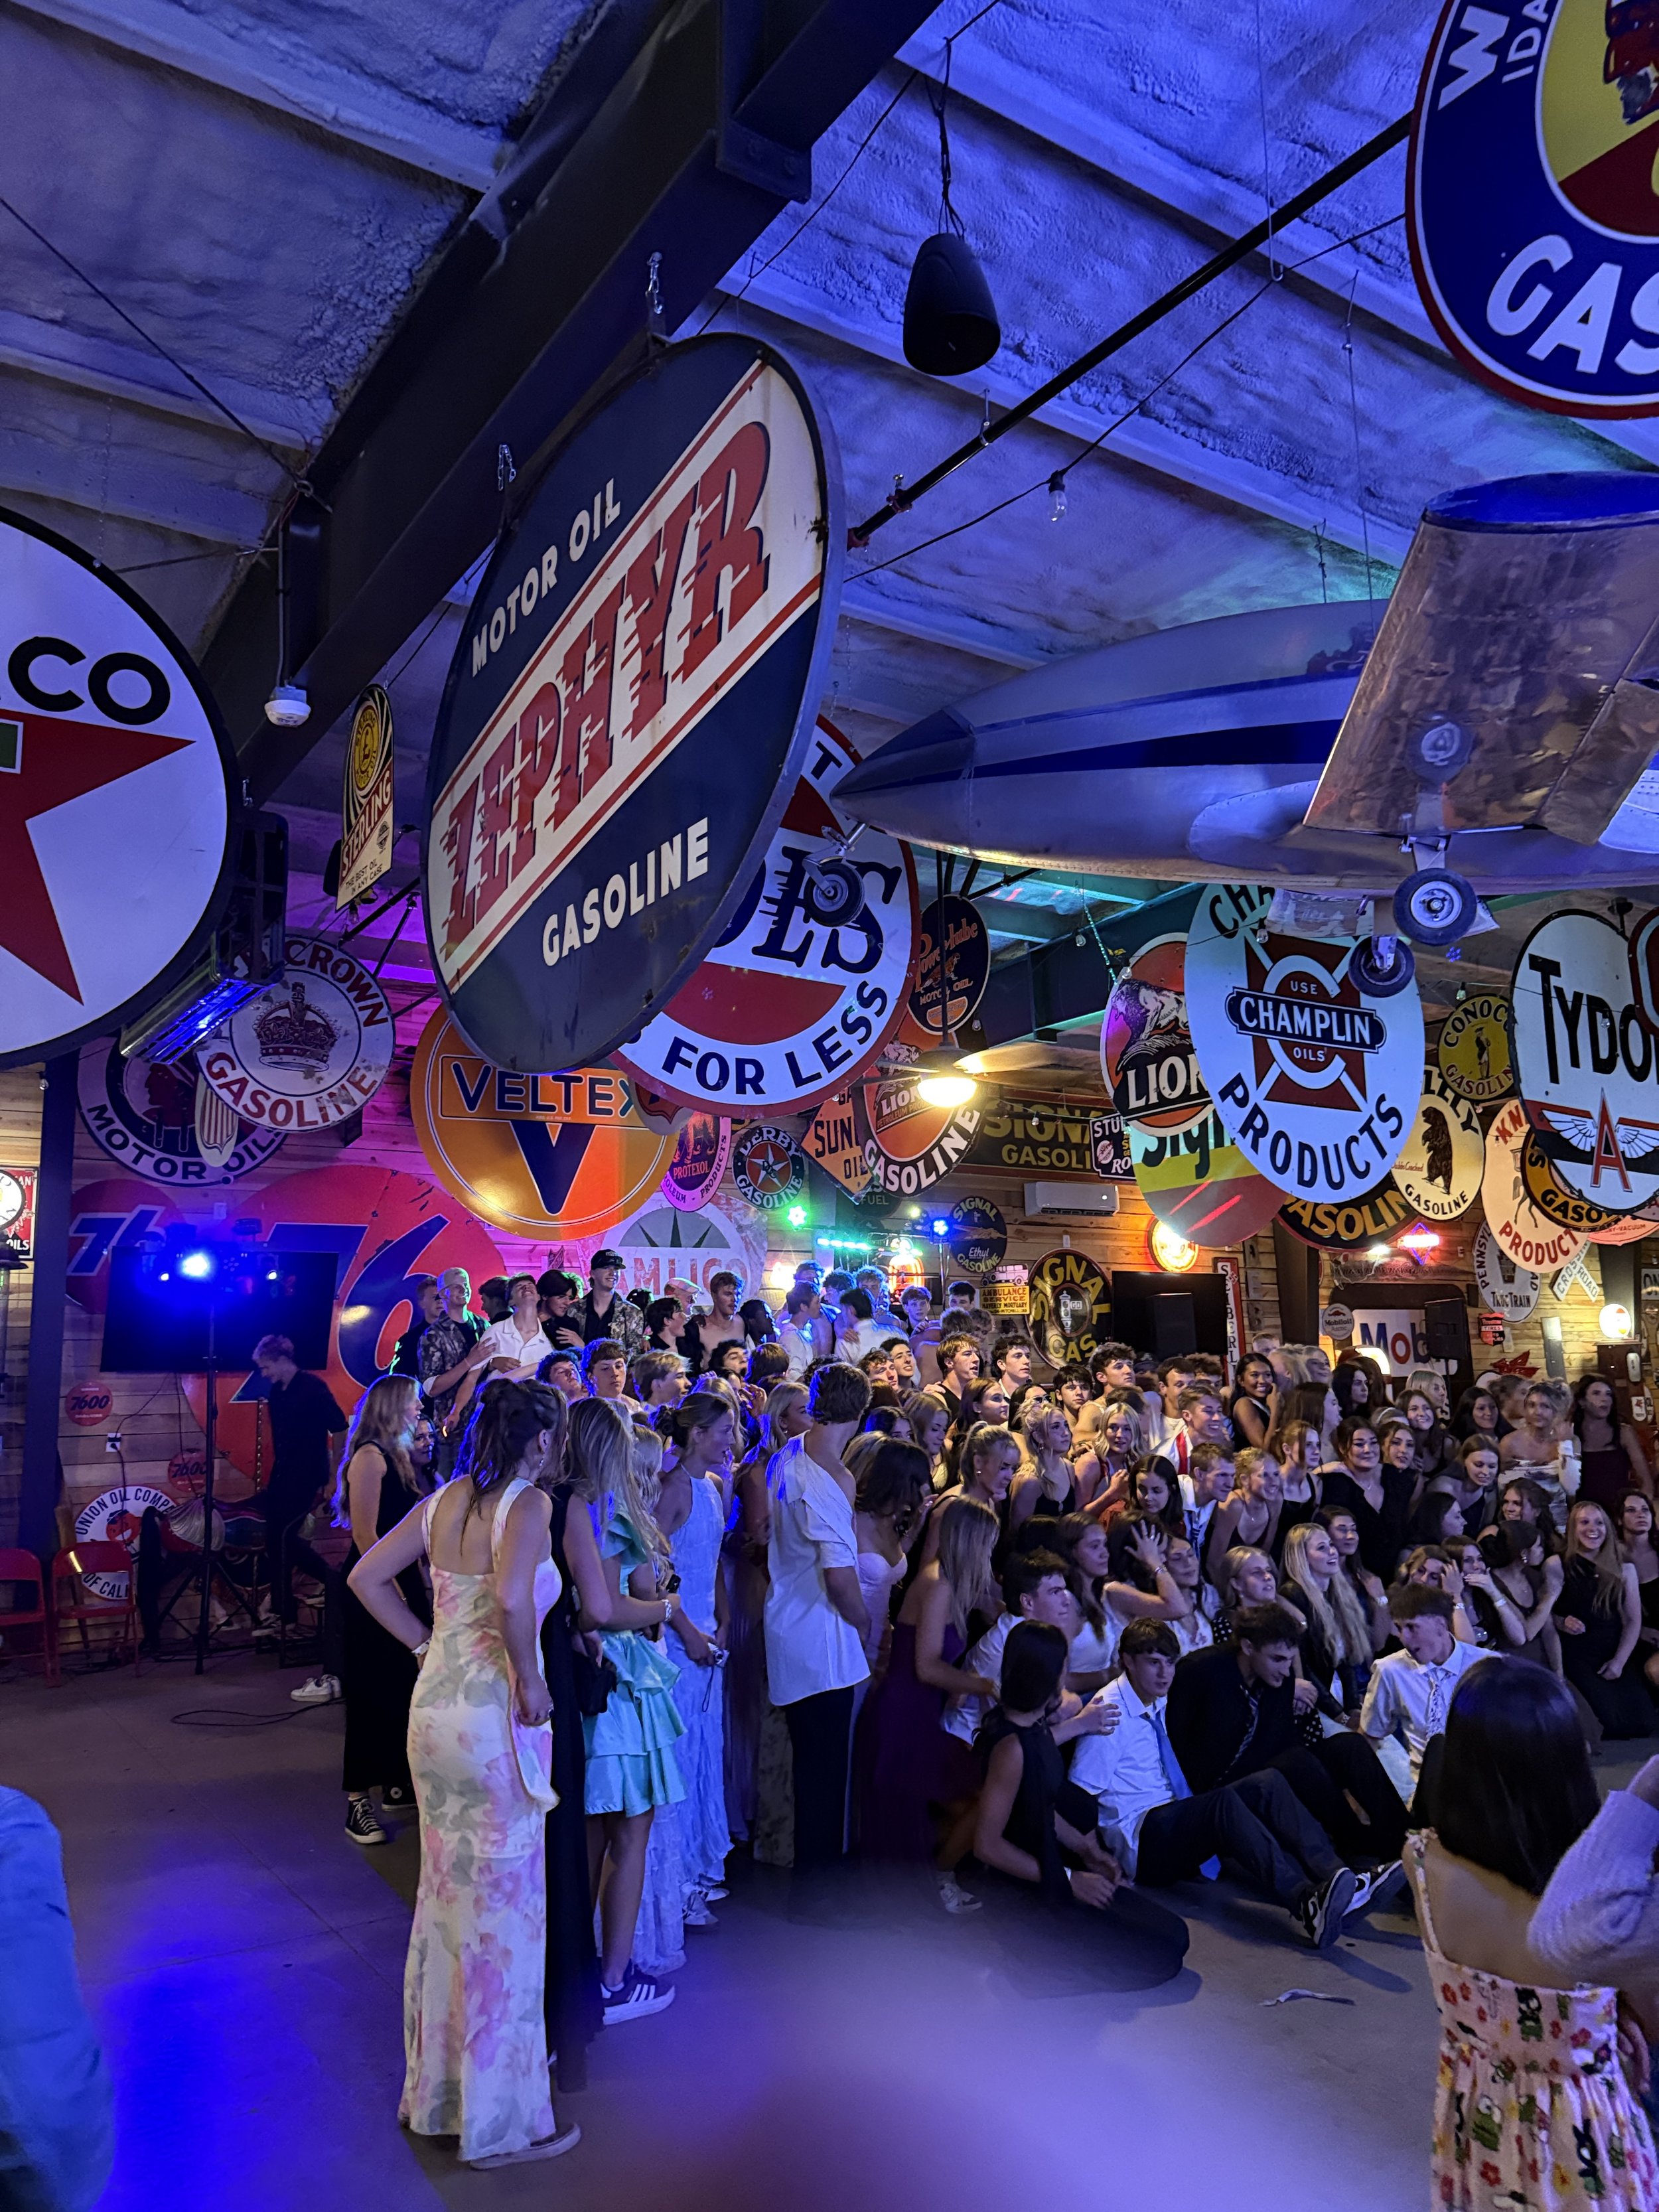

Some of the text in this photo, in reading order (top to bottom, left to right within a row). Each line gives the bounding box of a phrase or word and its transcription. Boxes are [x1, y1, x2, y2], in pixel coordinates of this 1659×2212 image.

[1502, 0, 1550, 84] IDA
[472, 477, 621, 678] MOTOR OIL
[8, 636, 171, 725] CO
[440, 421, 770, 962] ZEPHYR
[343, 769, 392, 878] STERLING
[346, 859, 378, 888] THE BEST OIL
[358, 877, 368, 889] ANY
[369, 863, 384, 881] CASE
[541, 817, 709, 967] GASOLINE
[285, 939, 389, 1028] CROWN
[952, 978, 974, 992] OIL
[1289, 980, 1318, 995] USE
[1240, 997, 1372, 1046] CHAMPLIN
[1528, 952, 1659, 1086] TYDO
[661, 980, 887, 1095] FOR LESS
[1293, 1046, 1326, 1063] OILS
[206, 1051, 378, 1128] GASOLINE
[1445, 1063, 1514, 1096] GASOLIN
[877, 1106, 908, 1128] PETROLEUM
[983, 1098, 1104, 1145] SIGNA
[1218, 1072, 1404, 1191] PRODUCTS
[87, 1104, 282, 1181] MOTOR OIL
[739, 1125, 802, 1159] DERBY
[865, 1106, 981, 1195] GASOLINE
[1001, 1143, 1092, 1170] GASOLI
[673, 1161, 711, 1180] PROTEXOL
[700, 1134, 728, 1199] PRODUCTS
[737, 1174, 803, 1209] GASOLINE
[1405, 1183, 1469, 1216] GASOLINE
[1541, 1189, 1603, 1224] GASO
[953, 1197, 998, 1222] SIGNAL
[968, 1246, 989, 1263] Ethyl
[1476, 1223, 1492, 1290] PENNSYL
[1498, 1220, 1579, 1266] PRODUCT
[957, 1252, 1001, 1273] GASOLINE
[982, 1287, 1027, 1297] AMBULANCE
[1030, 1255, 1112, 1325] SIGNAL
[1070, 1301, 1082, 1310] GO
[1325, 1317, 1352, 1326] Mobiloil
[1048, 1333, 1098, 1363] GAS
[1359, 1322, 1429, 1364] Mob
[70, 1394, 110, 1411] 7600
[76, 1488, 175, 1535] UNION OIL COMPA
[83, 1573, 102, 1587] OF
